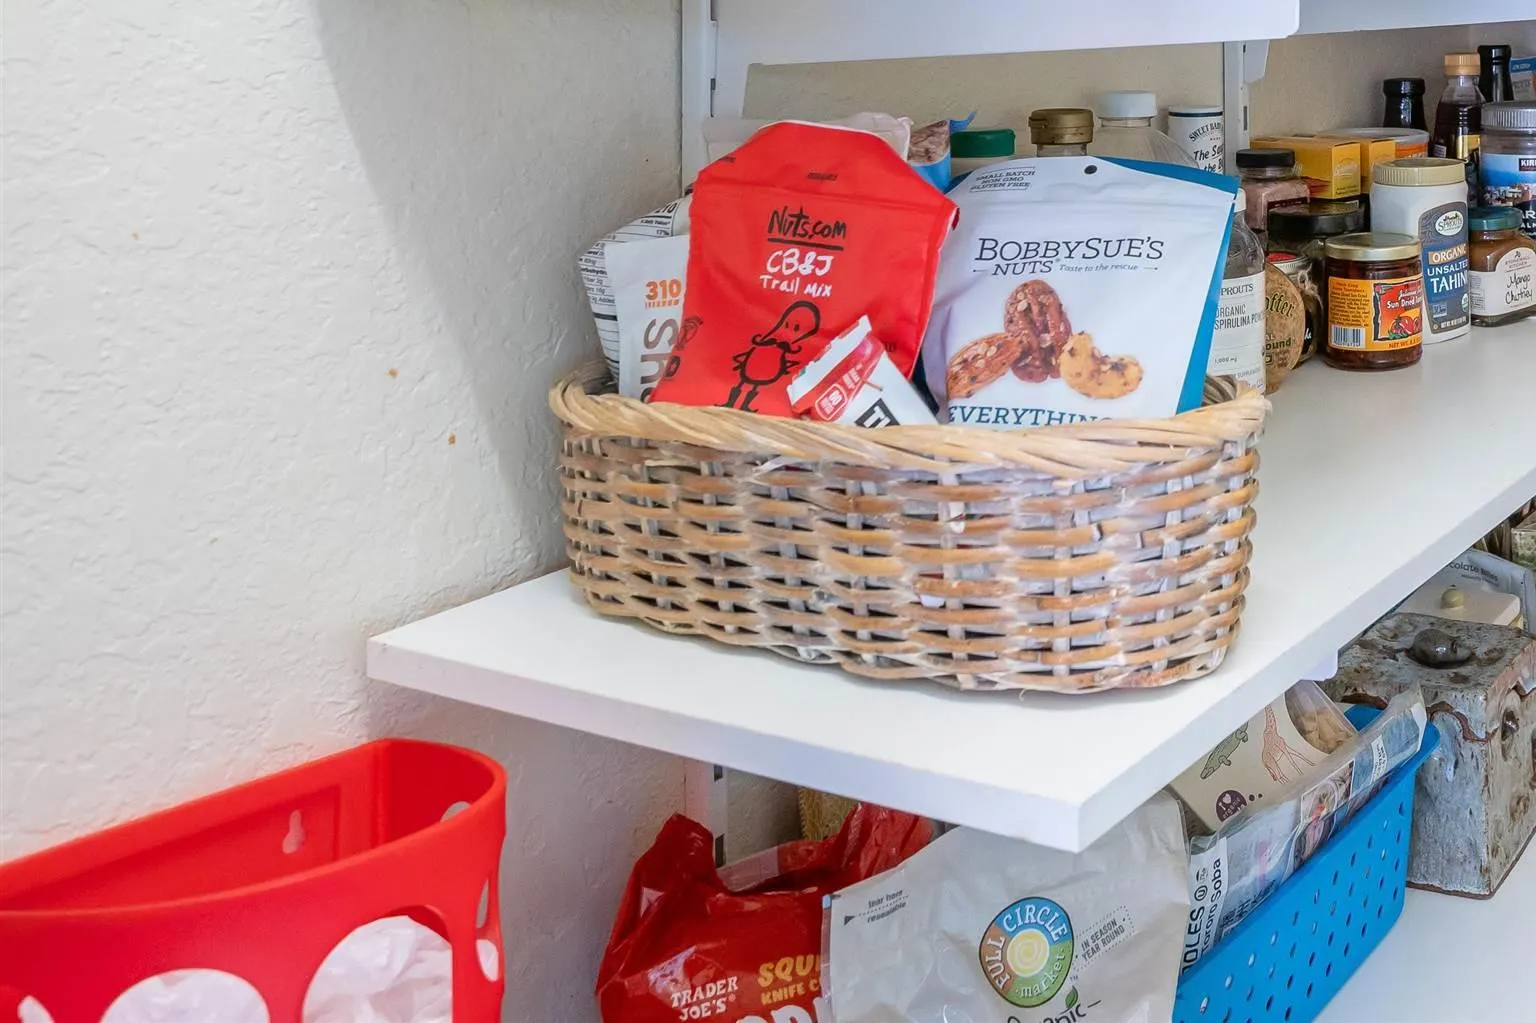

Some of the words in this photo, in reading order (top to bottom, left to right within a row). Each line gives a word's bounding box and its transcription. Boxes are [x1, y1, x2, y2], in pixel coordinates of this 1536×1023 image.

[1194, 149, 1209, 160] The
[975, 171, 1003, 181] SMALL
[1005, 169, 1036, 177] BATCH
[1204, 163, 1216, 172] the
[768, 205, 847, 241] Nuts.com
[766, 247, 834, 277] CB&J
[992, 260, 1054, 276] NUTS
[1059, 264, 1083, 272] Taste
[645, 279, 682, 300] 310
[759, 275, 800, 295] Trail
[1507, 273, 1531, 289] Mango
[1401, 299, 1415, 307] Dried
[1505, 289, 1532, 304] Chutney
[1215, 316, 1250, 330] SPIRULINA
[1211, 858, 1222, 903] Soba
[868, 896, 884, 909] tear
[885, 889, 904, 901] here
[867, 901, 907, 924] resealable
[1003, 904, 1068, 943] CIRCLE
[1081, 941, 1090, 951] IN
[1090, 919, 1118, 943] SEASON
[1082, 943, 1101, 962] YEAR
[1103, 925, 1126, 947] ROUND
[985, 935, 1011, 990] FULL
[1020, 954, 1067, 998] market
[671, 976, 739, 1008] TRADER
[761, 988, 805, 1005] KNIFE
[679, 997, 727, 1021] JOE'S
